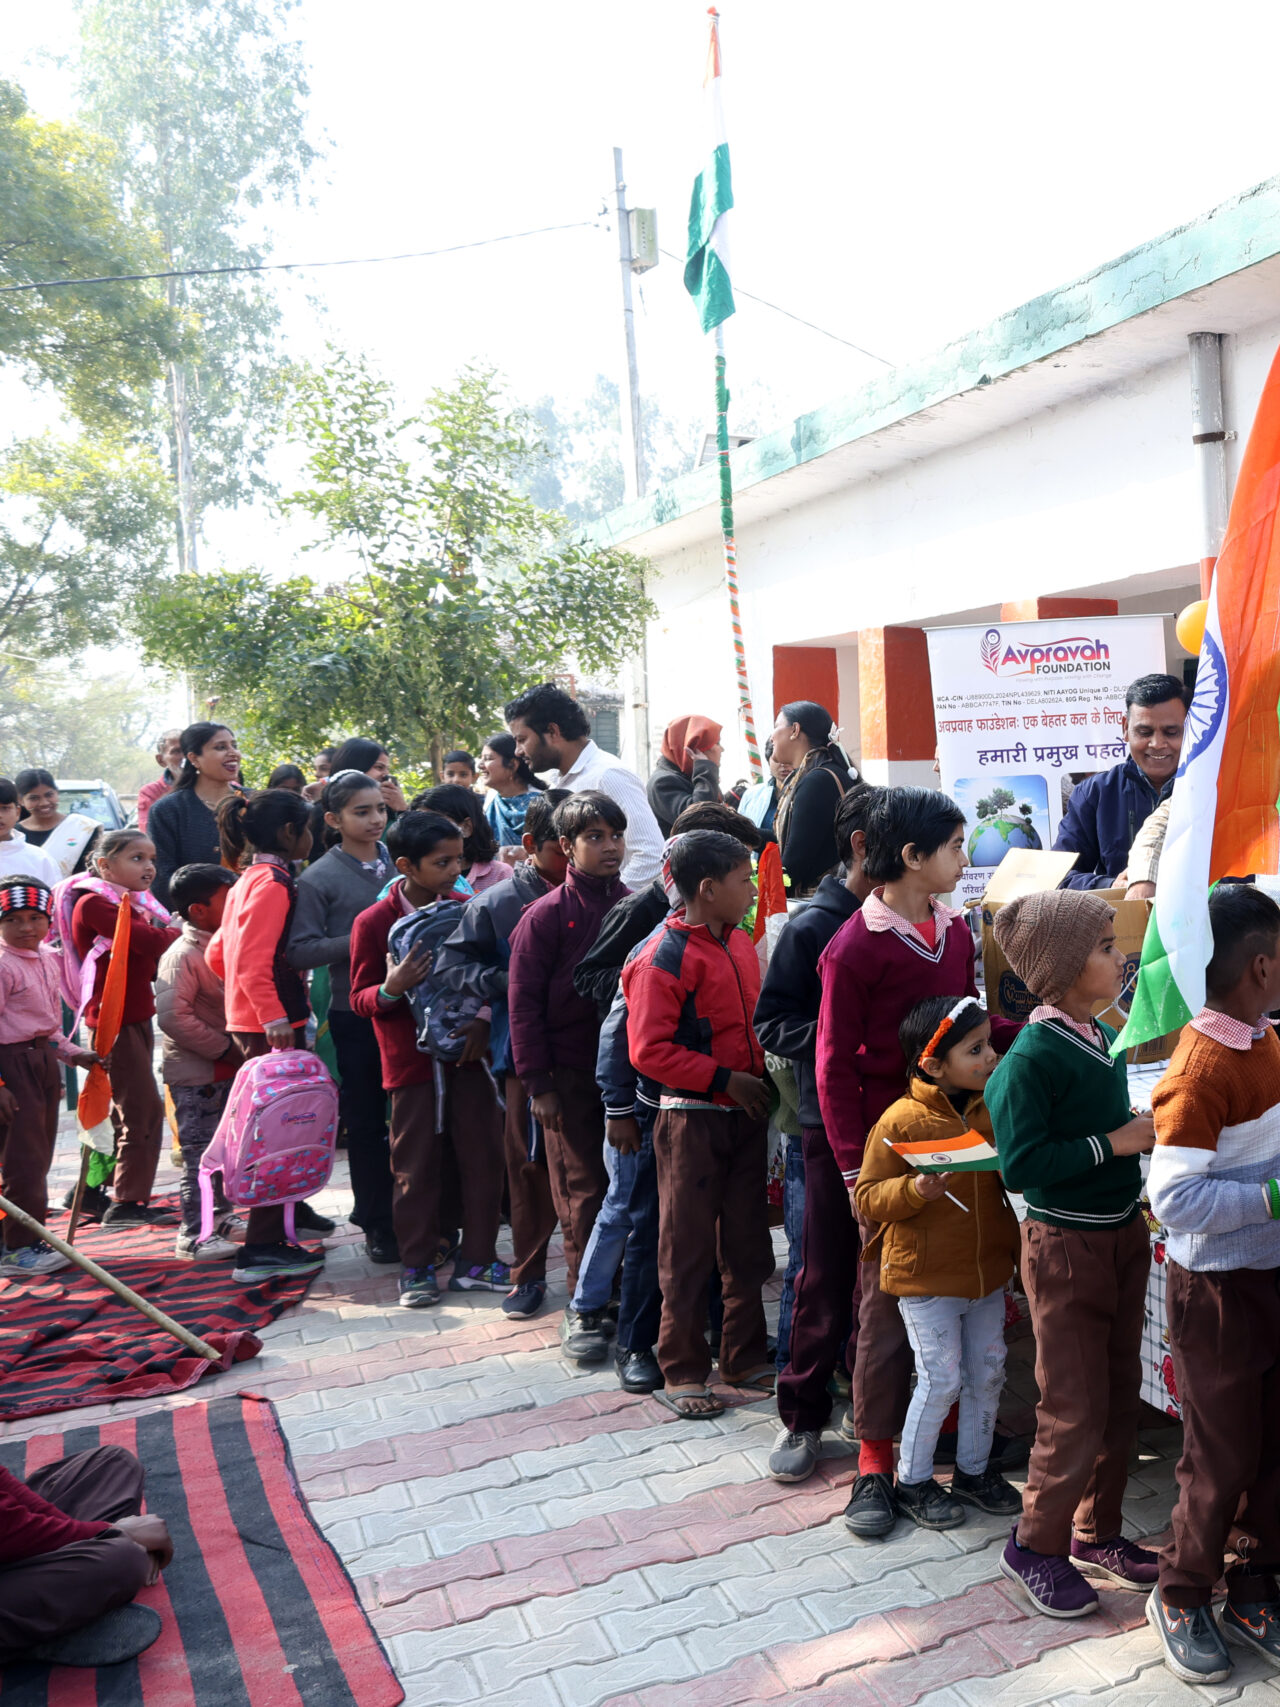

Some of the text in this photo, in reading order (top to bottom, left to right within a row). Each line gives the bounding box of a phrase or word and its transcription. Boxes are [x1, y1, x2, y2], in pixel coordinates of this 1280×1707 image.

[1001, 639, 1110, 673] Avpravah
[1036, 660, 1111, 675] FOUNDATION
[1079, 687, 1101, 695] Unique
[938, 718, 973, 734] अवप्रवाह
[1023, 715, 1039, 730] एक
[1041, 709, 1067, 729] बेहतर
[1069, 713, 1088, 726] कल
[1090, 707, 1101, 725] के
[1103, 706, 1123, 725] लिए
[977, 741, 1027, 767] हमारी
[1033, 743, 1079, 768] प्रमुख
